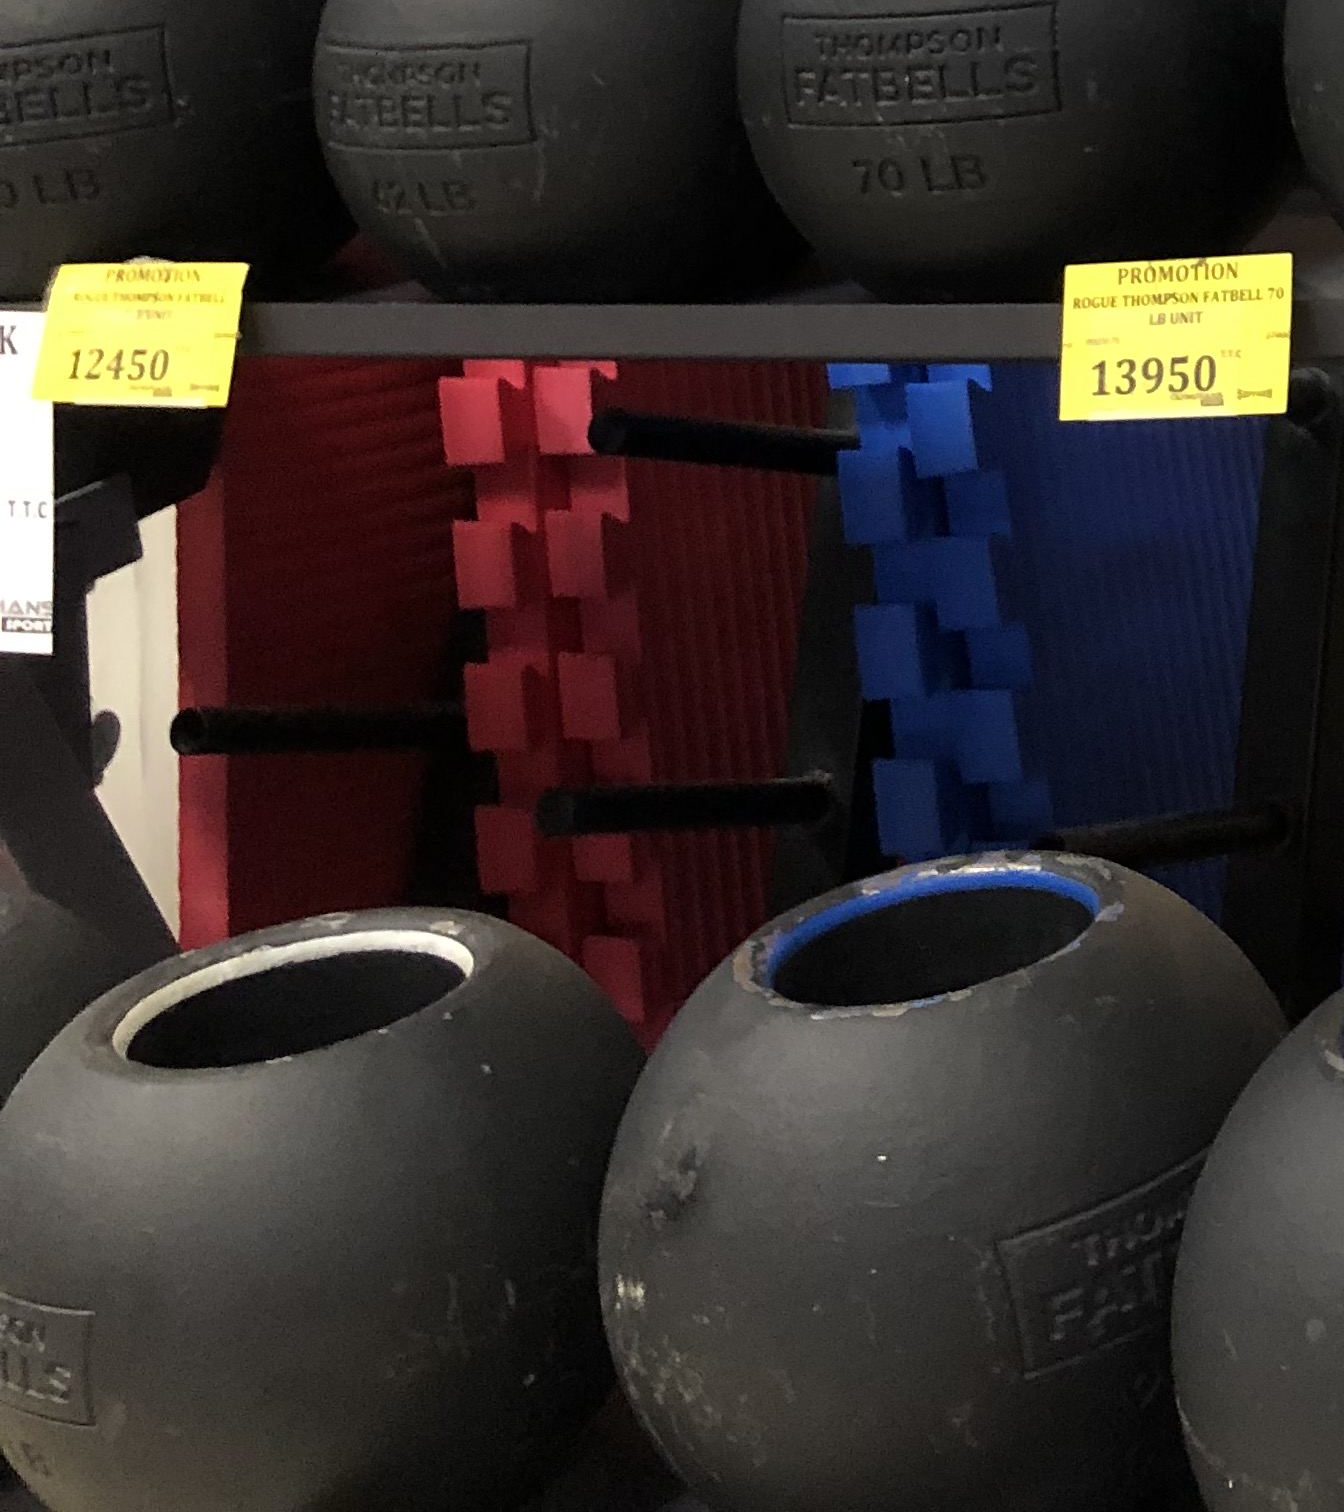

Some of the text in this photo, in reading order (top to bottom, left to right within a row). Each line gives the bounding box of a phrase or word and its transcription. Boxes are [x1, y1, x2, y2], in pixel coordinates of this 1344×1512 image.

[814, 24, 1002, 62] THOMPSON
[794, 52, 1039, 108] FATBELLS
[852, 154, 987, 195] 70 LB
[106, 268, 201, 283] PROMOTION
[1117, 262, 1239, 285] PROMOTION
[1072, 287, 1284, 310] ROGUE THOMPSON FATBELL 70
[1149, 311, 1203, 326] LB UNIT
[68, 348, 170, 381] 12450
[1092, 355, 1216, 396] 13950
